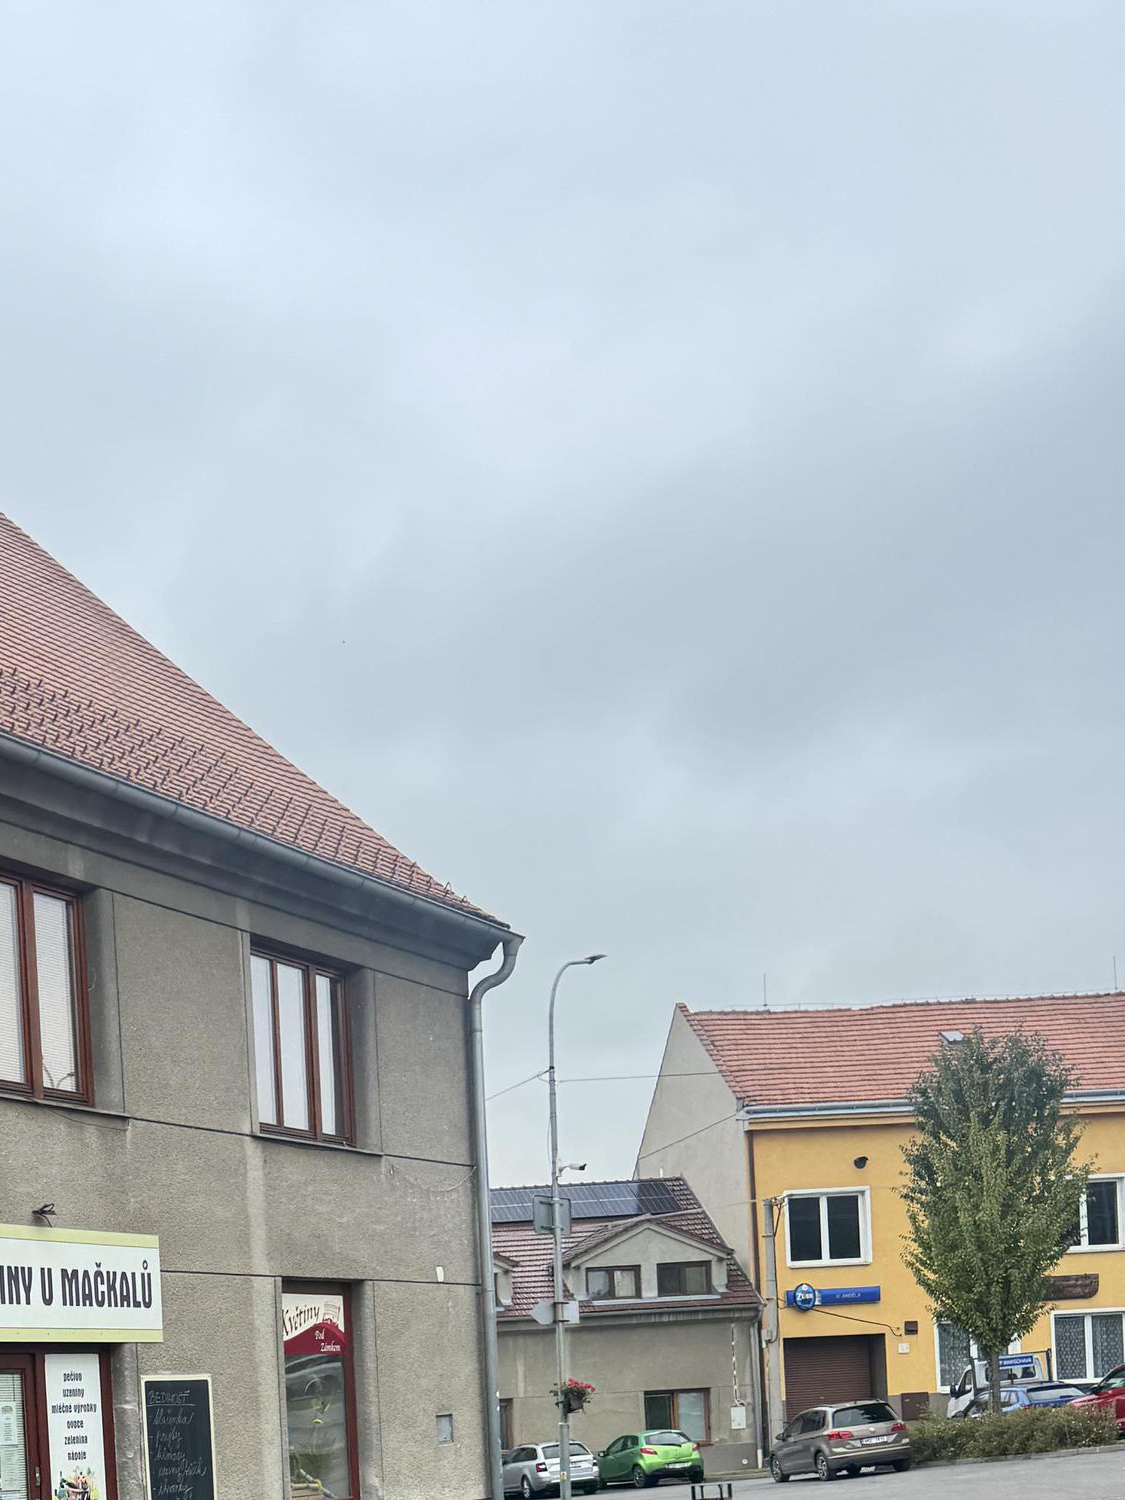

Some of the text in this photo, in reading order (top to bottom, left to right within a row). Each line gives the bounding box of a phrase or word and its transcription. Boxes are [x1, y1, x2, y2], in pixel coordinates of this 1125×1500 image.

[40, 1267, 54, 1306] U
[61, 1259, 153, 1309] MAČKALŮ
[282, 1304, 320, 1336] Květiny
[66, 1419, 84, 1429] ovoce
